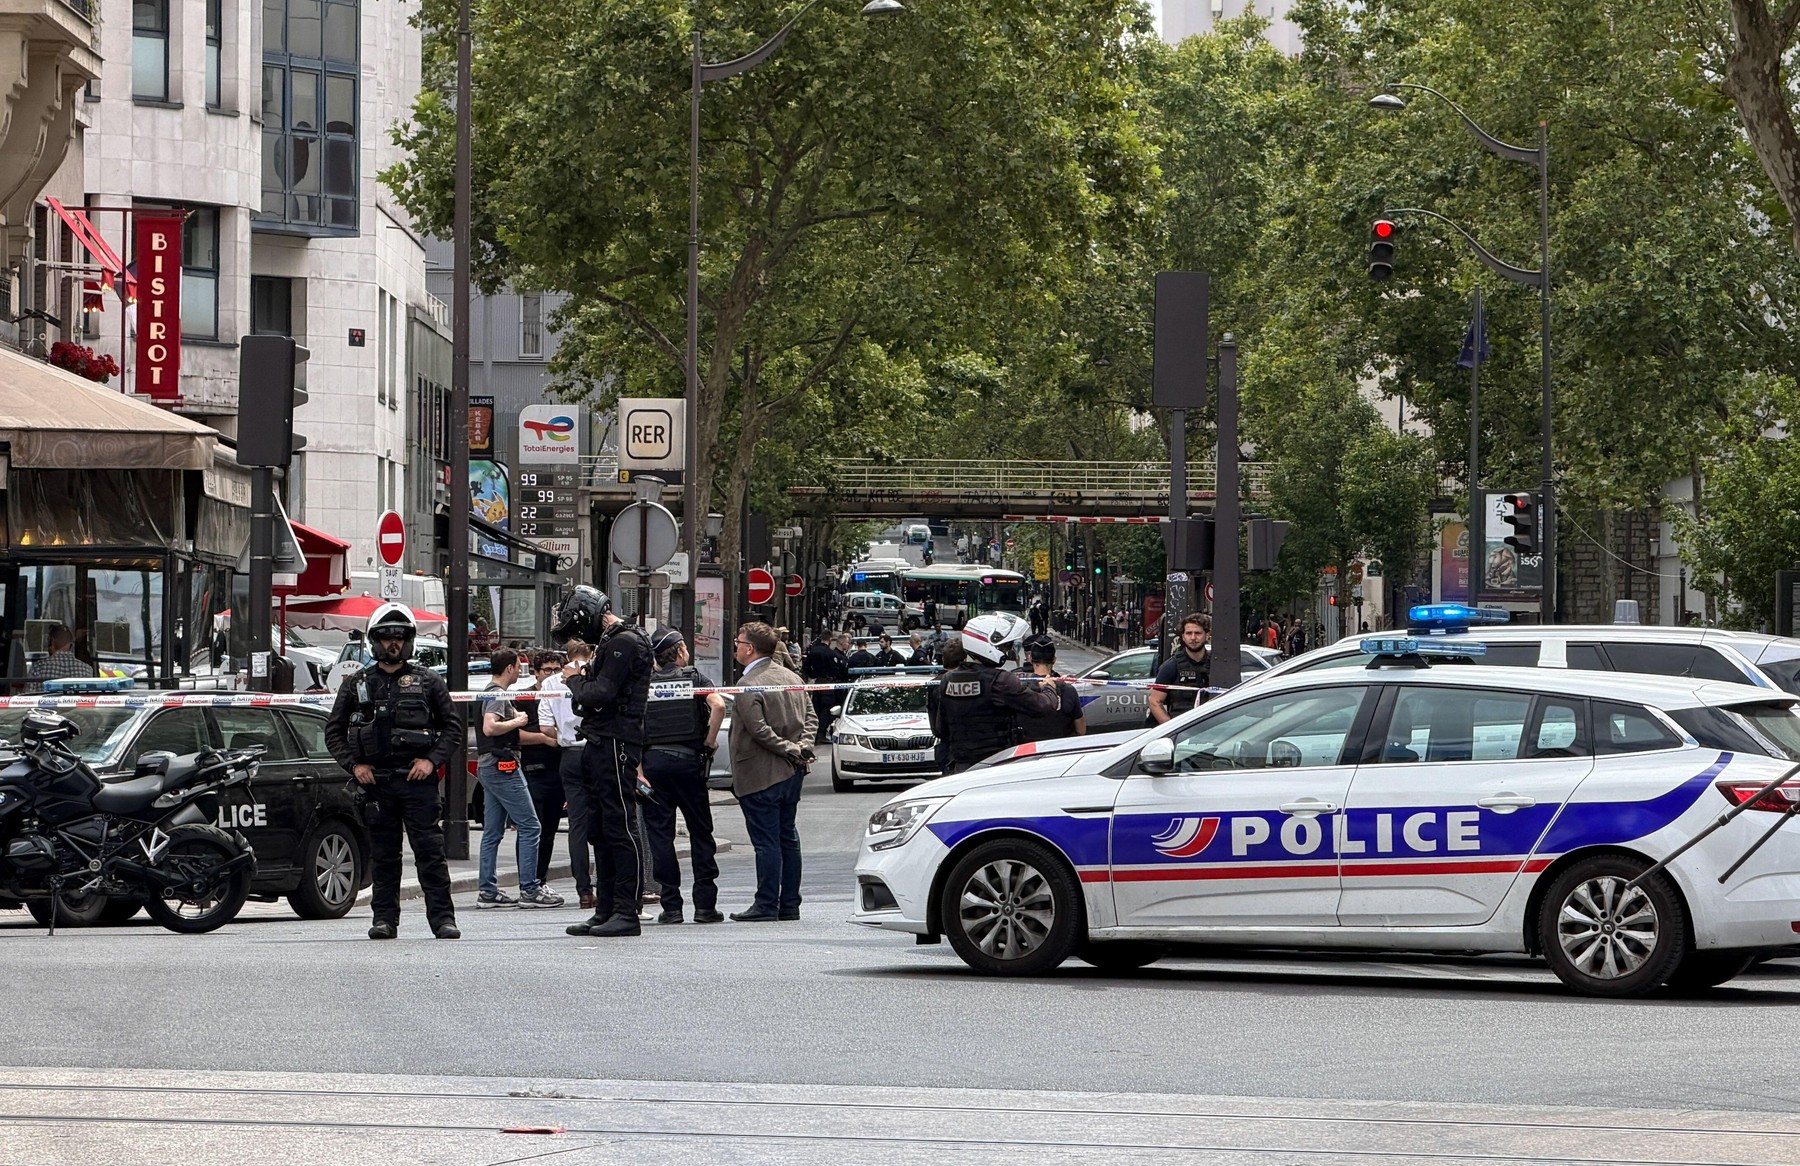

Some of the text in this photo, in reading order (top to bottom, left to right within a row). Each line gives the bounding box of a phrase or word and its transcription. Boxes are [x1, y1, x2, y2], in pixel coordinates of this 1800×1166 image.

[147, 232, 168, 385] BISTROT
[632, 425, 665, 443] RER
[523, 445, 575, 453] TotalEnergies
[385, 569, 398, 577] SAUF
[1106, 694, 1147, 705] POLI
[218, 803, 267, 828] LICE
[1231, 811, 1480, 856] POLICE
